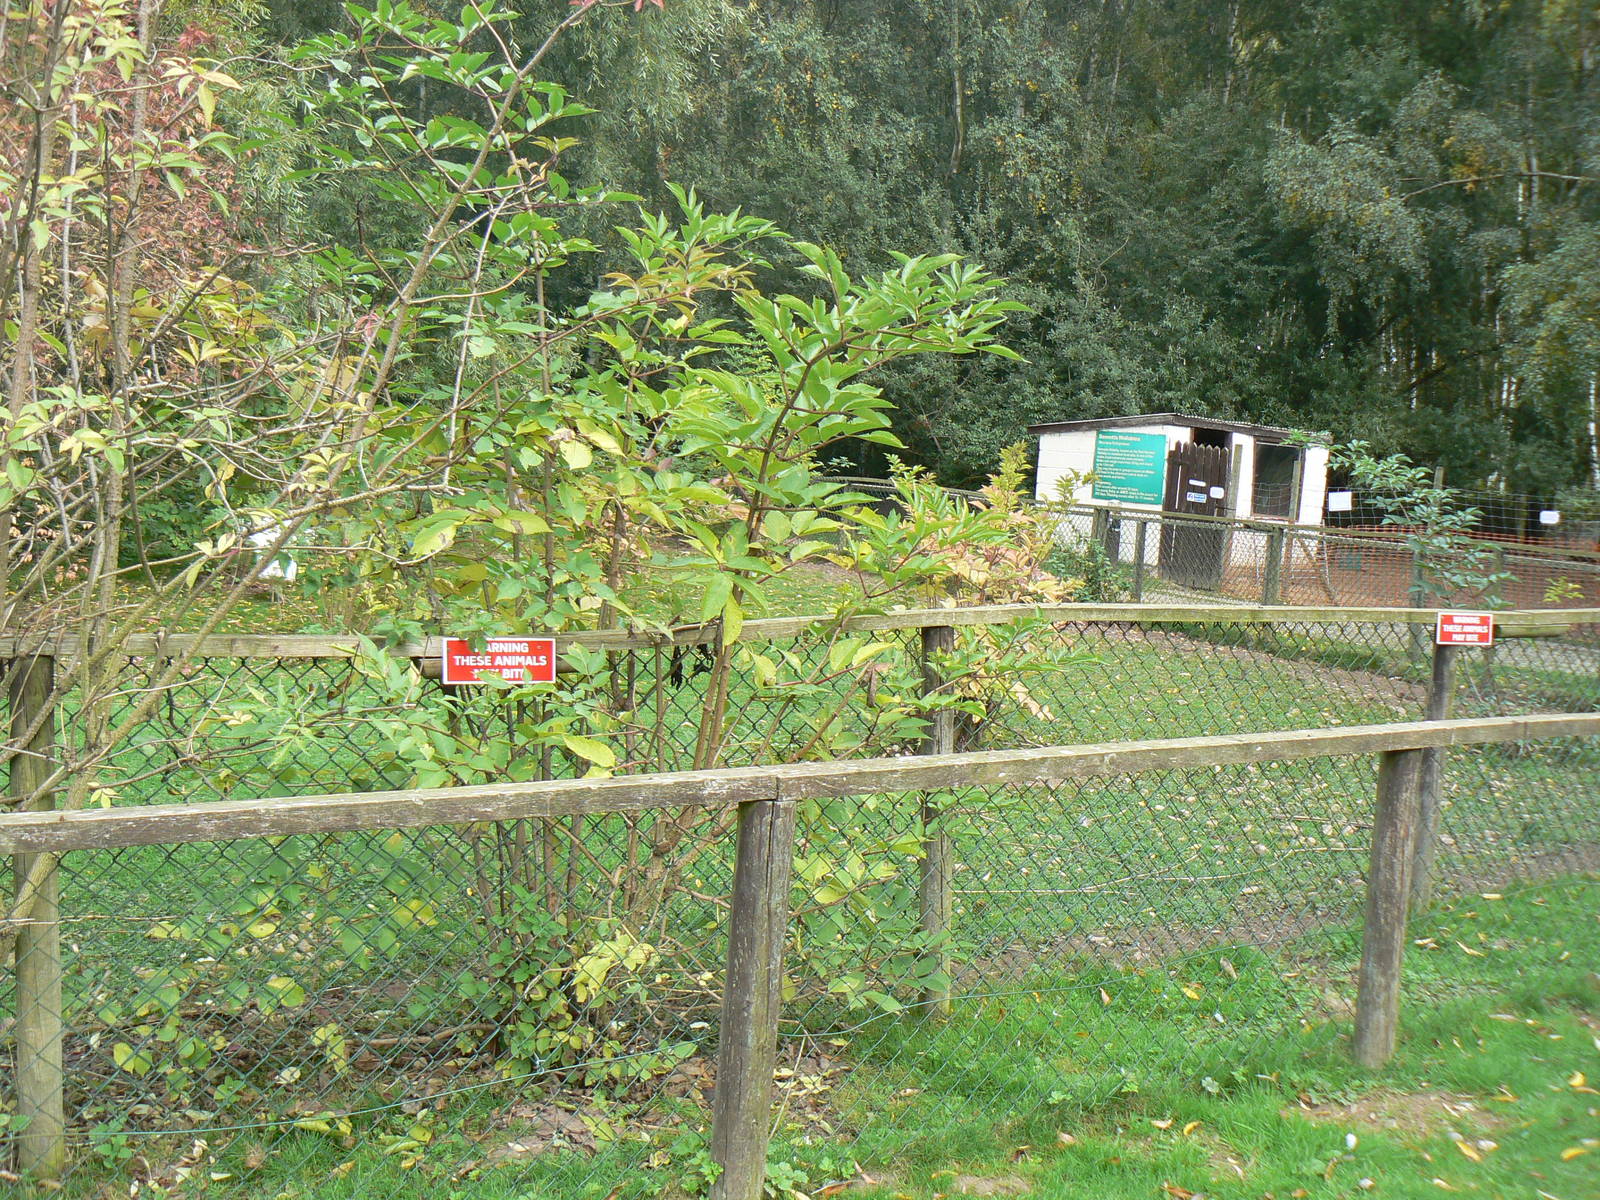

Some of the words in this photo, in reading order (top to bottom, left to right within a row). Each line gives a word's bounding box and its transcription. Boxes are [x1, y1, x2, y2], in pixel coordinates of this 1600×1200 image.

[473, 642, 529, 653] ARNING
[453, 655, 492, 666] THESE
[494, 655, 547, 666] ANIMALS
[502, 668, 525, 679] BIT
